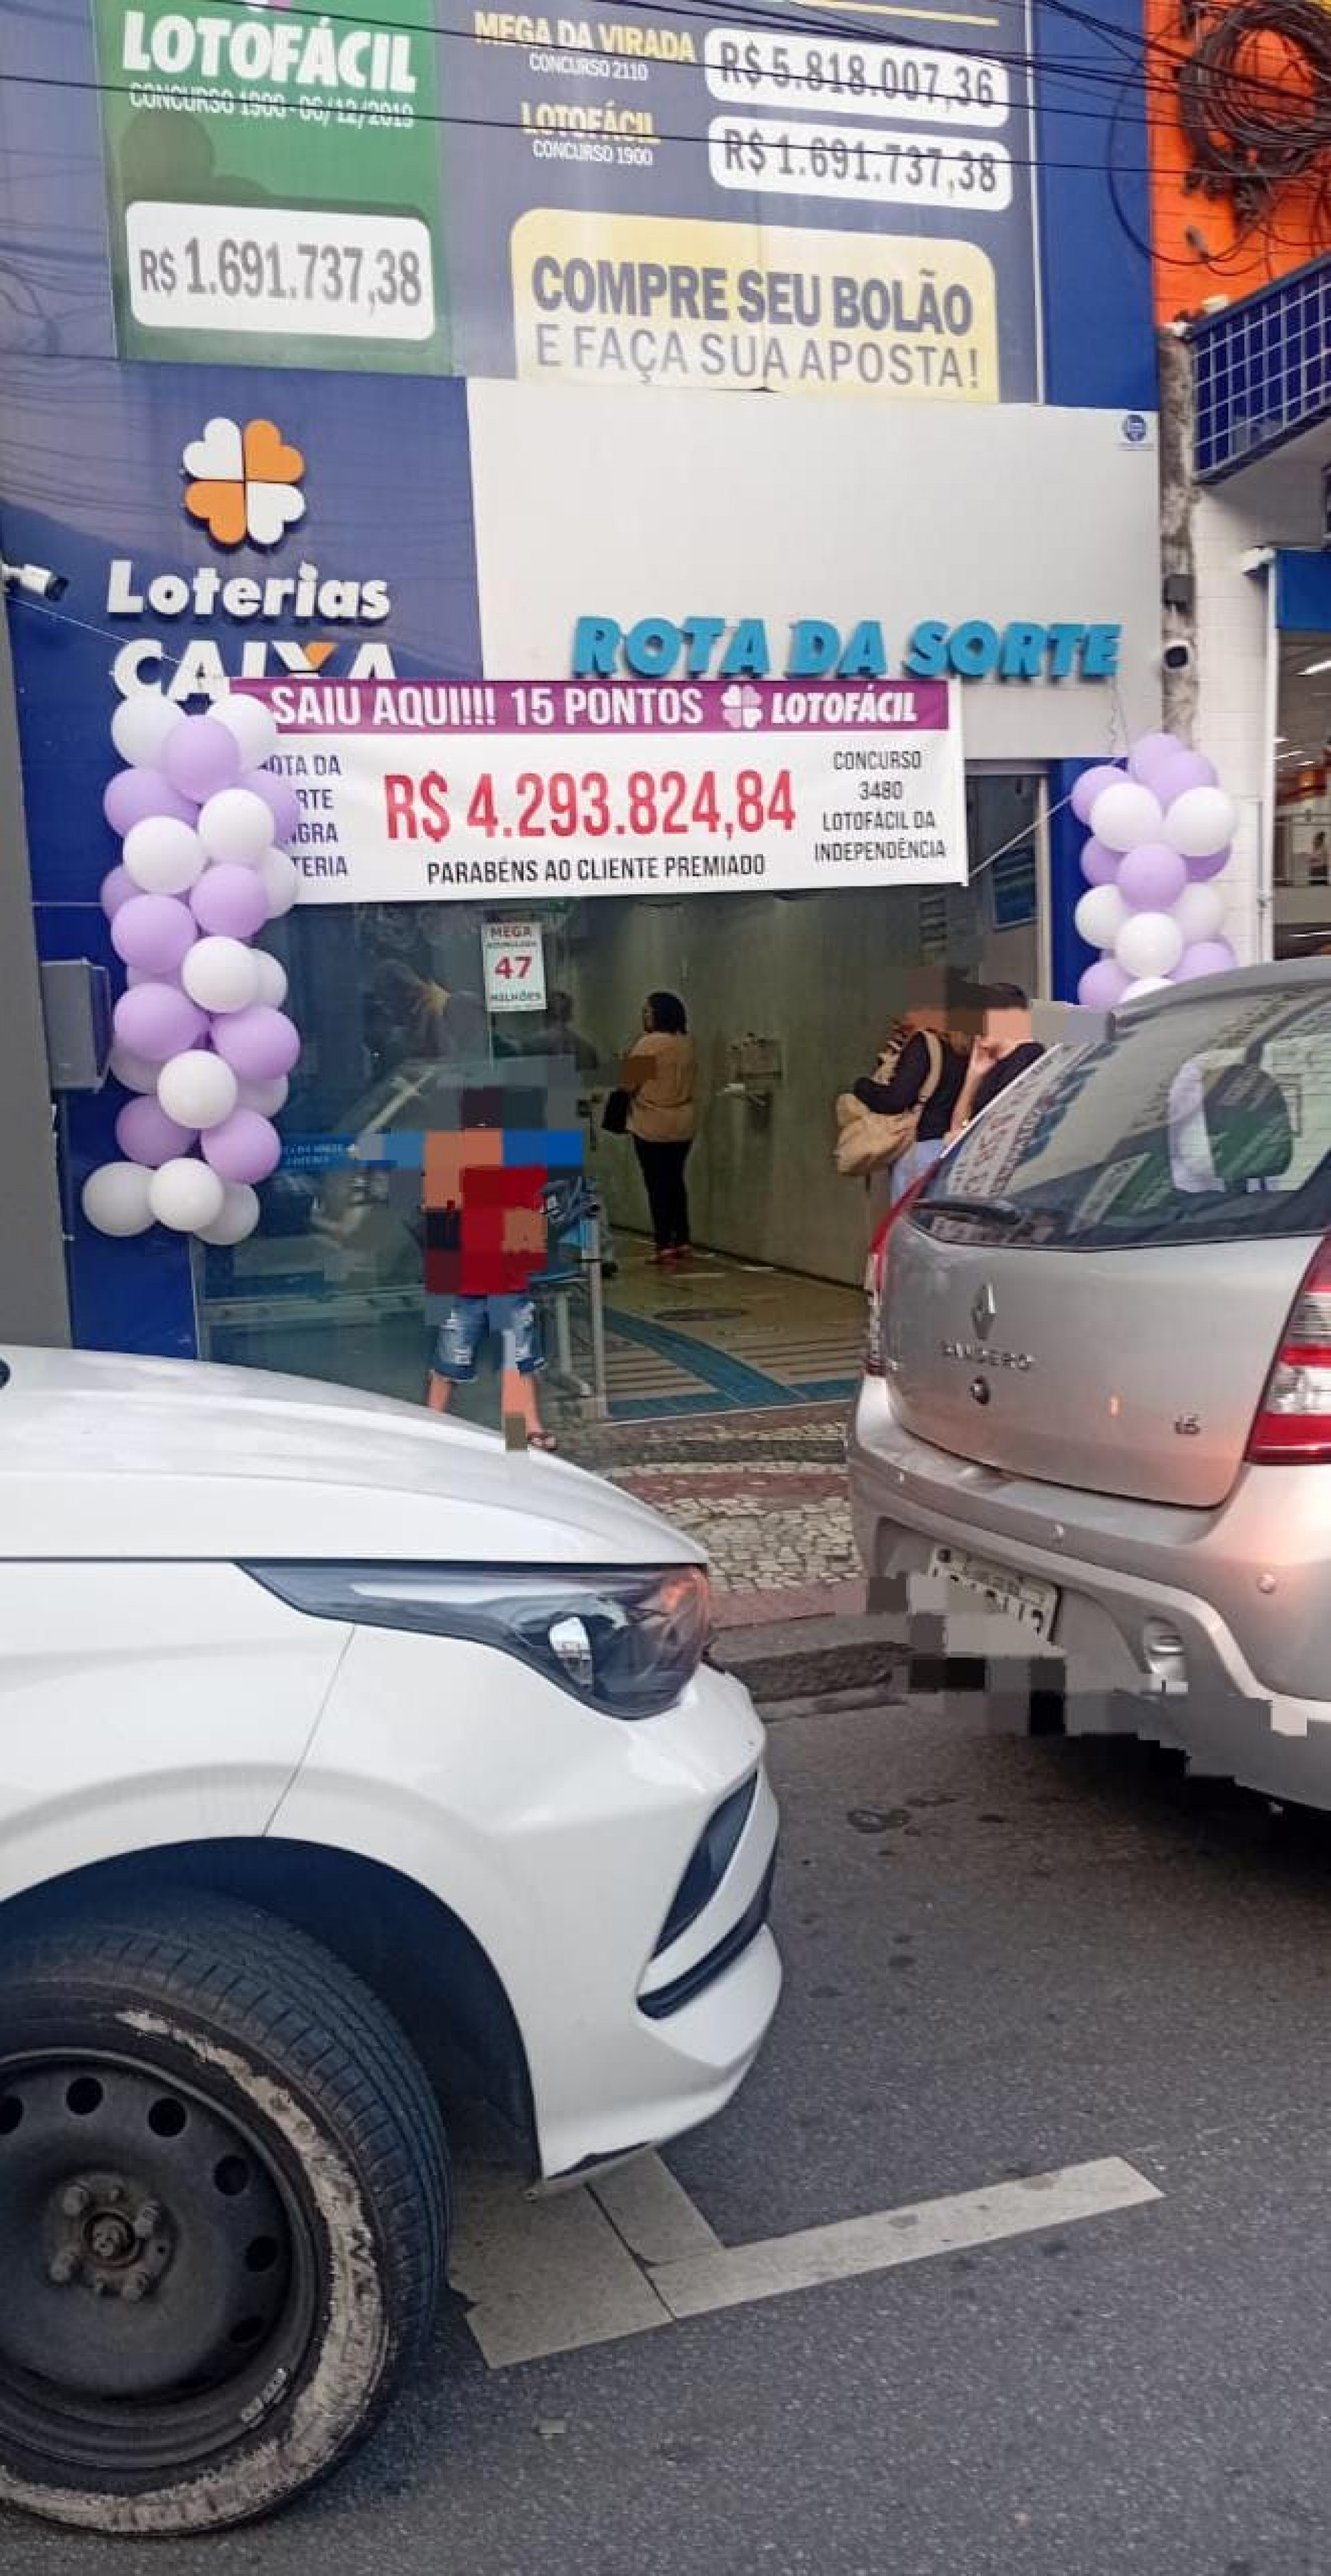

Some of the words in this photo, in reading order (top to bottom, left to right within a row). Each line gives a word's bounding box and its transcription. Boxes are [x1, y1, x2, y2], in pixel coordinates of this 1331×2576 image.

[122, 11, 417, 93] LOTOFÁCIL
[473, 11, 552, 49] MEGA
[557, 19, 595, 50] DA
[598, 24, 697, 63] VIRADA
[529, 52, 609, 78] CONCURSO
[613, 61, 648, 81] 2110
[720, 42, 762, 89] R$
[772, 48, 994, 112] 5.818.007,36
[129, 82, 235, 114] CONCURSO
[521, 99, 661, 144] LOTOFÁCIL
[533, 139, 613, 163] CONCURSO
[617, 147, 653, 166] 1900
[724, 129, 764, 175] R$
[779, 133, 996, 198] 1.691.737,38
[139, 247, 177, 297] R$
[185, 237, 421, 314] 1.691.737,38
[533, 256, 729, 322] COMPRE
[738, 271, 821, 327] SEU
[833, 267, 973, 337] BOLÃO
[537, 325, 563, 367] E
[575, 326, 688, 385] FAÇA
[701, 333, 789, 381] SUA
[799, 338, 979, 390] APOSTA!
[107, 559, 392, 620] Loterias
[573, 616, 771, 678] ROTA
[786, 620, 888, 677] DA
[905, 621, 1121, 683] SORTE
[270, 685, 361, 726] SAIU
[373, 686, 497, 727] AQUI!!!
[512, 687, 555, 726] 15
[564, 688, 703, 726] PONTOS
[771, 685, 917, 725] LOTOFÁCIL
[269, 754, 307, 776] OTA
[313, 754, 342, 776] DA
[833, 751, 922, 769] CONCURSO
[295, 789, 335, 810] RTE
[384, 770, 451, 843] R$
[467, 769, 796, 840] 4.293.824,84
[859, 781, 903, 800] 3480
[914, 810, 936, 828] DA
[815, 837, 946, 862] INDEPENDÊNCIA
[428, 855, 539, 885] PARABÉNS
[545, 860, 571, 882] AO
[577, 858, 659, 881] CLIENTE
[665, 853, 765, 878] PREMIADO
[490, 925, 532, 938] MEGA
[494, 956, 532, 980] 47
